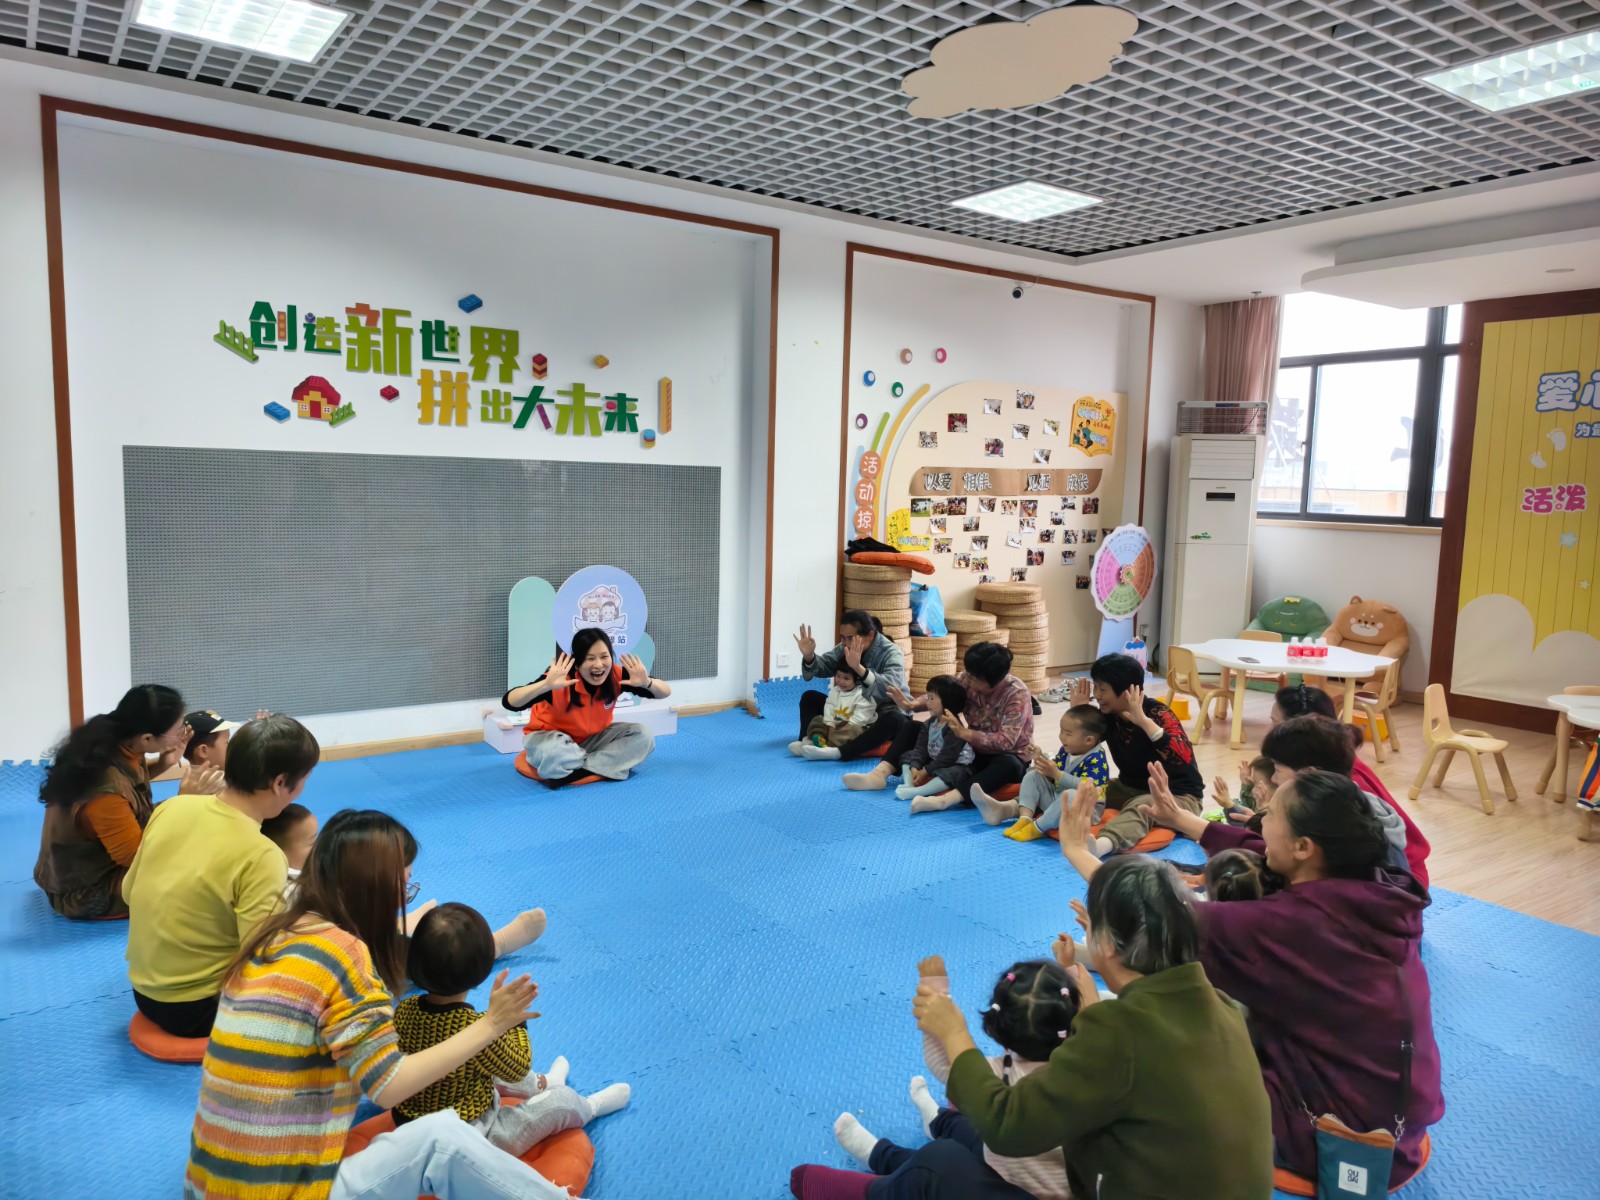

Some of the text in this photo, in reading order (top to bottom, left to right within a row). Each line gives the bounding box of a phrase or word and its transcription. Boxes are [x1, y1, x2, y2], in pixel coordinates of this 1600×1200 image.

[249, 301, 520, 384] 创造新世界
[923, 472, 952, 492] 以爱
[1026, 472, 1050, 492] 见证
[1066, 473, 1089, 492] 成长
[1521, 484, 1587, 514] 活泼
